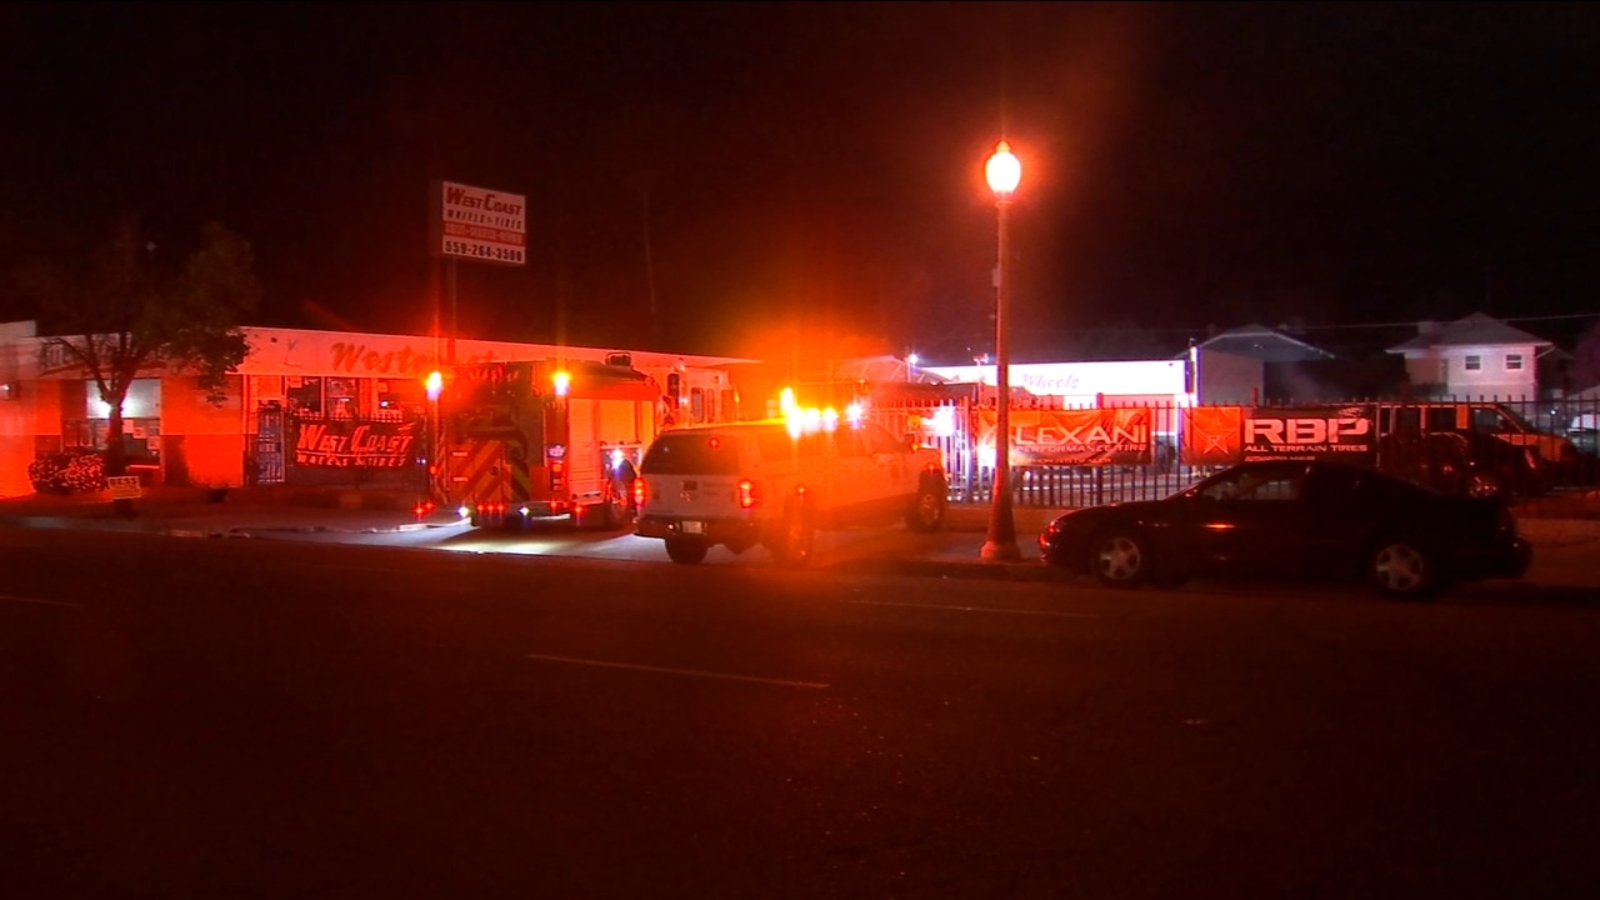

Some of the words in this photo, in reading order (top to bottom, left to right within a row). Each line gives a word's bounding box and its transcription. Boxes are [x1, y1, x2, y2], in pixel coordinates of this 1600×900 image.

[446, 186, 482, 209] WEST
[1021, 373, 1080, 390] Wheels
[296, 423, 348, 452] WEST
[1014, 423, 1148, 446] LEXANI
[1244, 418, 1369, 445] RBP
[1015, 444, 1112, 453] PERFORMANCE
[1244, 444, 1269, 453] ALL
[1271, 444, 1327, 453] TERRAIN
[1330, 444, 1368, 453] TIRES
